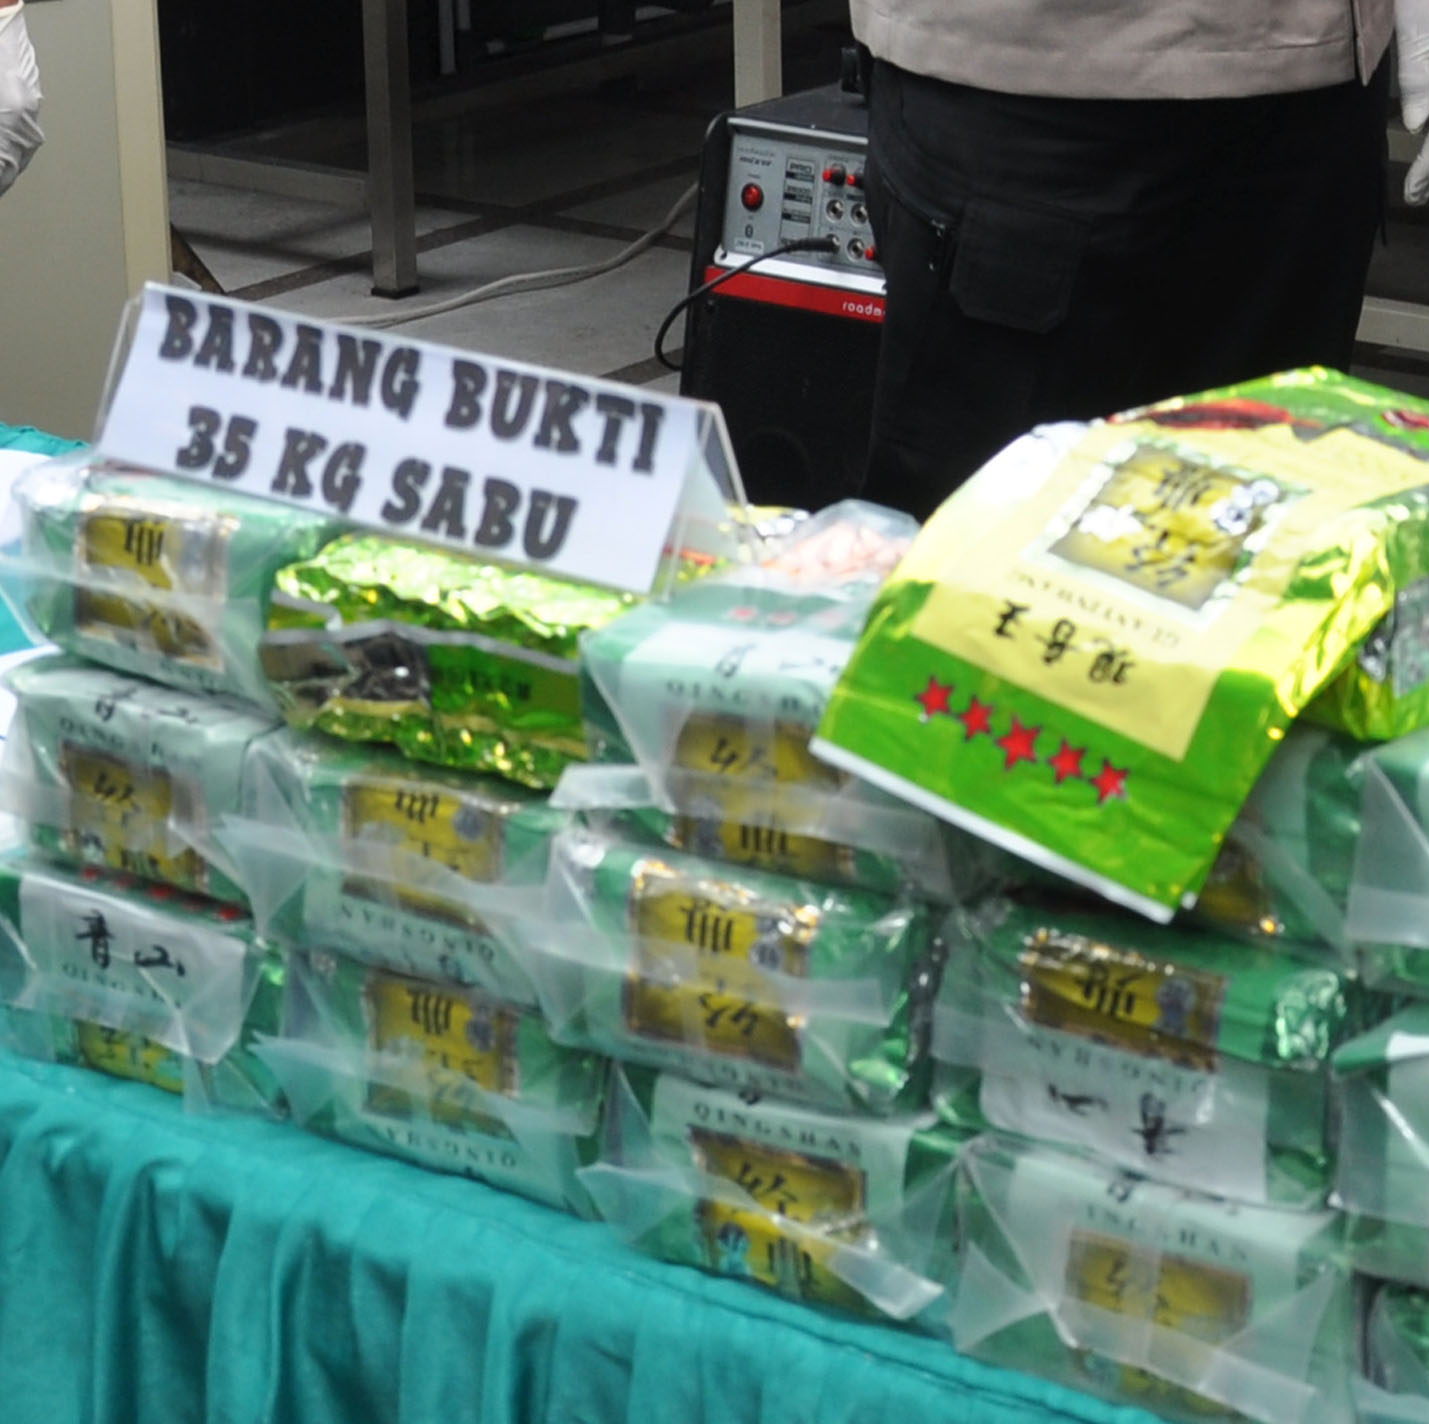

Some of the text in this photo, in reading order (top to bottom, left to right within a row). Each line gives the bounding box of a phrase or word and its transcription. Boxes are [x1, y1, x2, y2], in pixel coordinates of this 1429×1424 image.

[157, 293, 666, 476] BARANG BUKTI
[173, 404, 580, 563] 35 KG SABU
[690, 1100, 864, 1160] QINGSHAN
